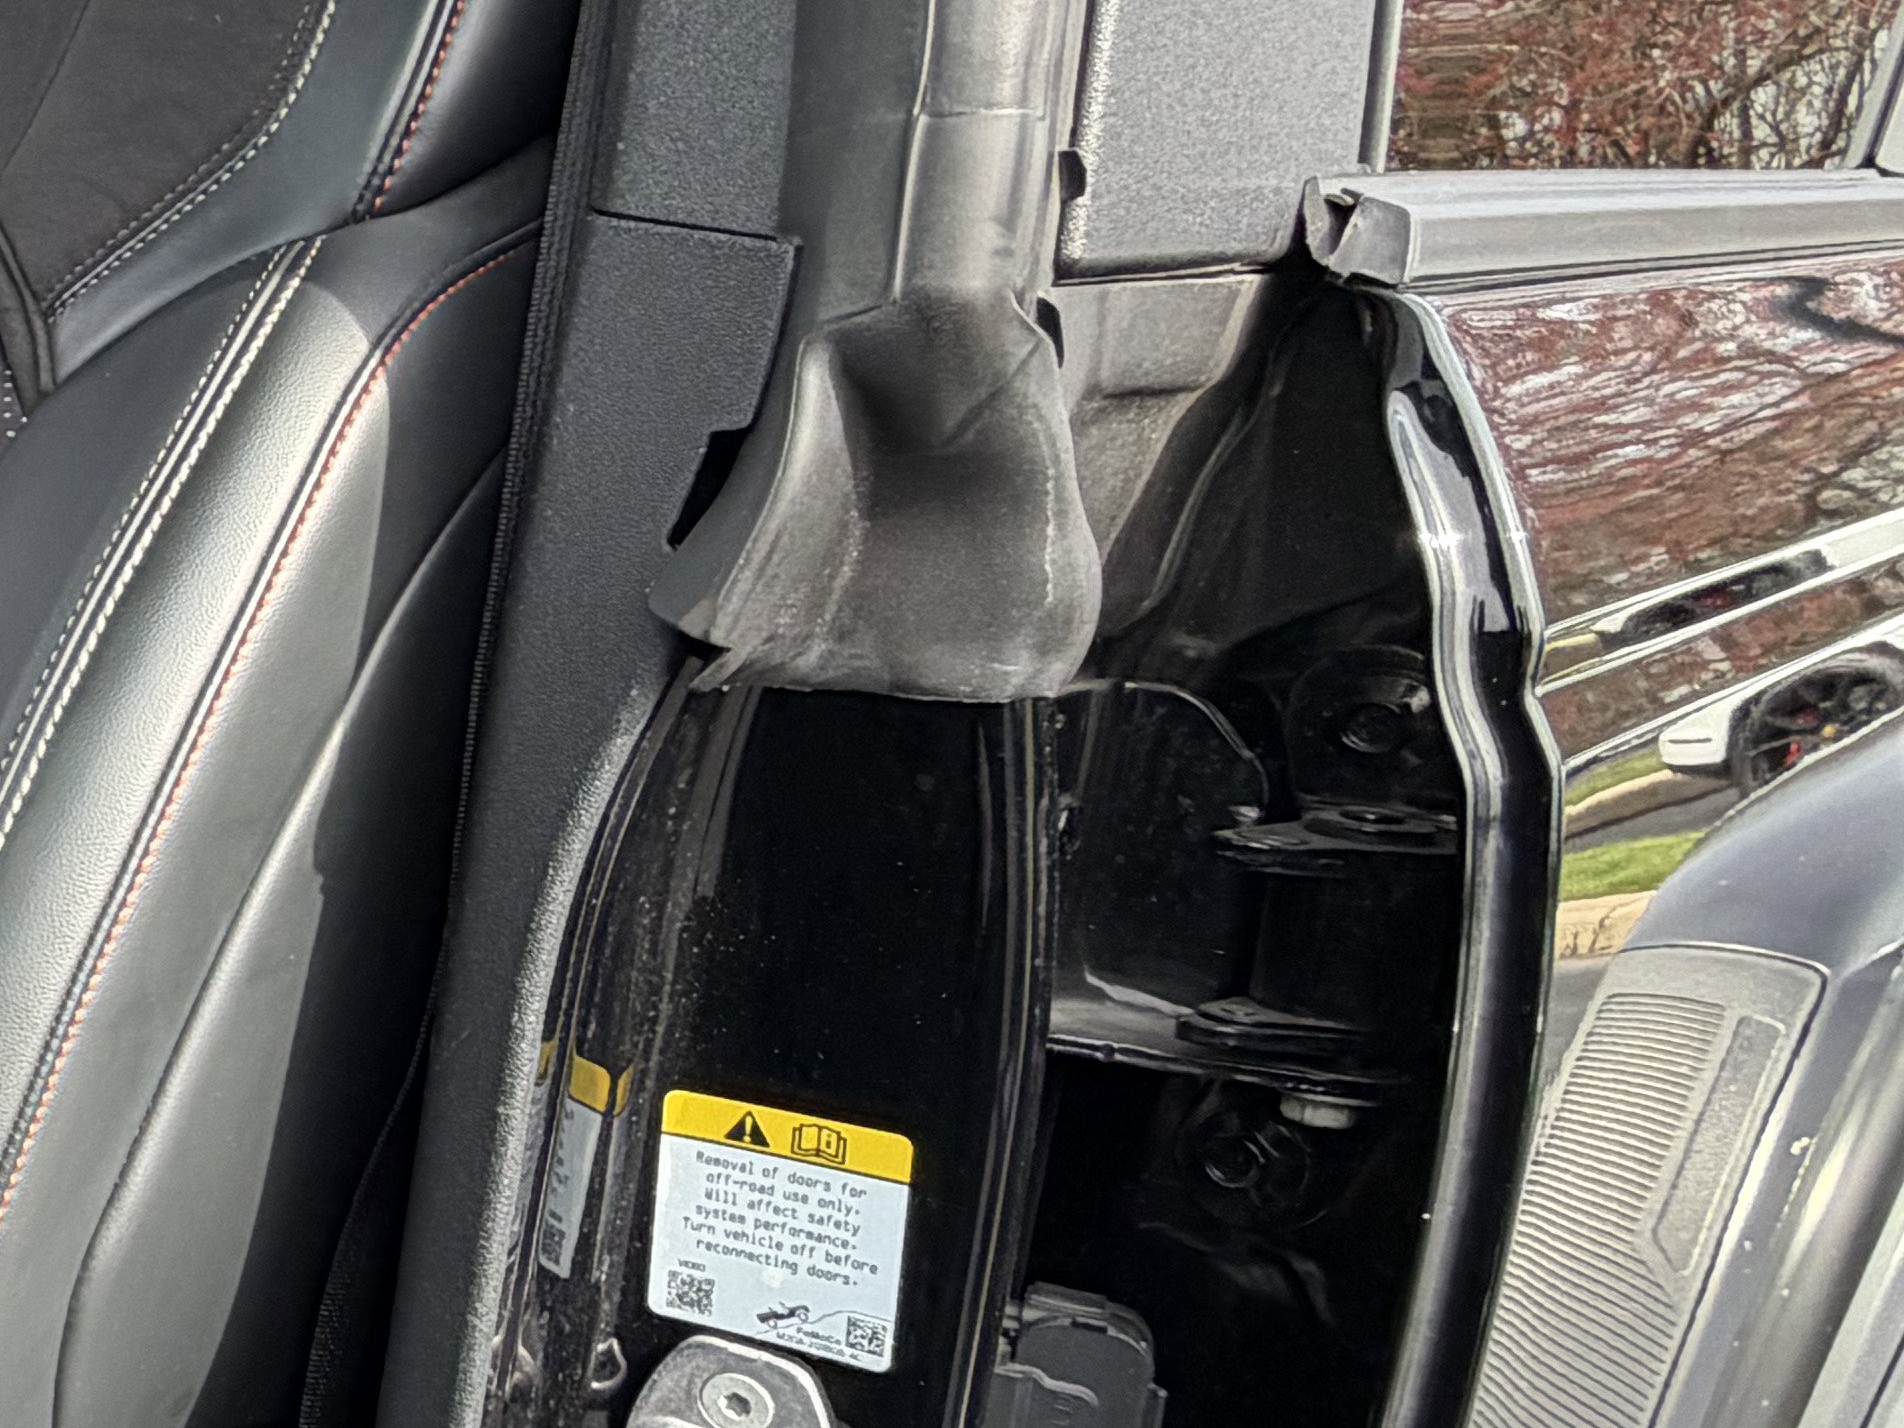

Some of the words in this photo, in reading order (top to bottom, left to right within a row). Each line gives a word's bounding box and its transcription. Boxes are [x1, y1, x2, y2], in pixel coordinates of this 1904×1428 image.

[696, 1151, 753, 1176] Removal
[762, 1166, 779, 1179] of
[787, 1172, 831, 1192] doors
[842, 1183, 867, 1198] for
[706, 1173, 775, 1197] off-road
[783, 1189, 809, 1204] use
[818, 1198, 860, 1216] only.
[695, 1204, 746, 1224] system
[754, 1218, 857, 1249] performance.
[704, 1188, 738, 1206] Will
[747, 1198, 798, 1219] affect
[807, 1212, 861, 1237] safety
[683, 1216, 715, 1235] Turn
[724, 1228, 784, 1251] vehicle
[791, 1244, 816, 1258] off
[825, 1249, 878, 1274] before
[696, 1238, 798, 1275] reconnecting
[807, 1264, 858, 1286] doors.
